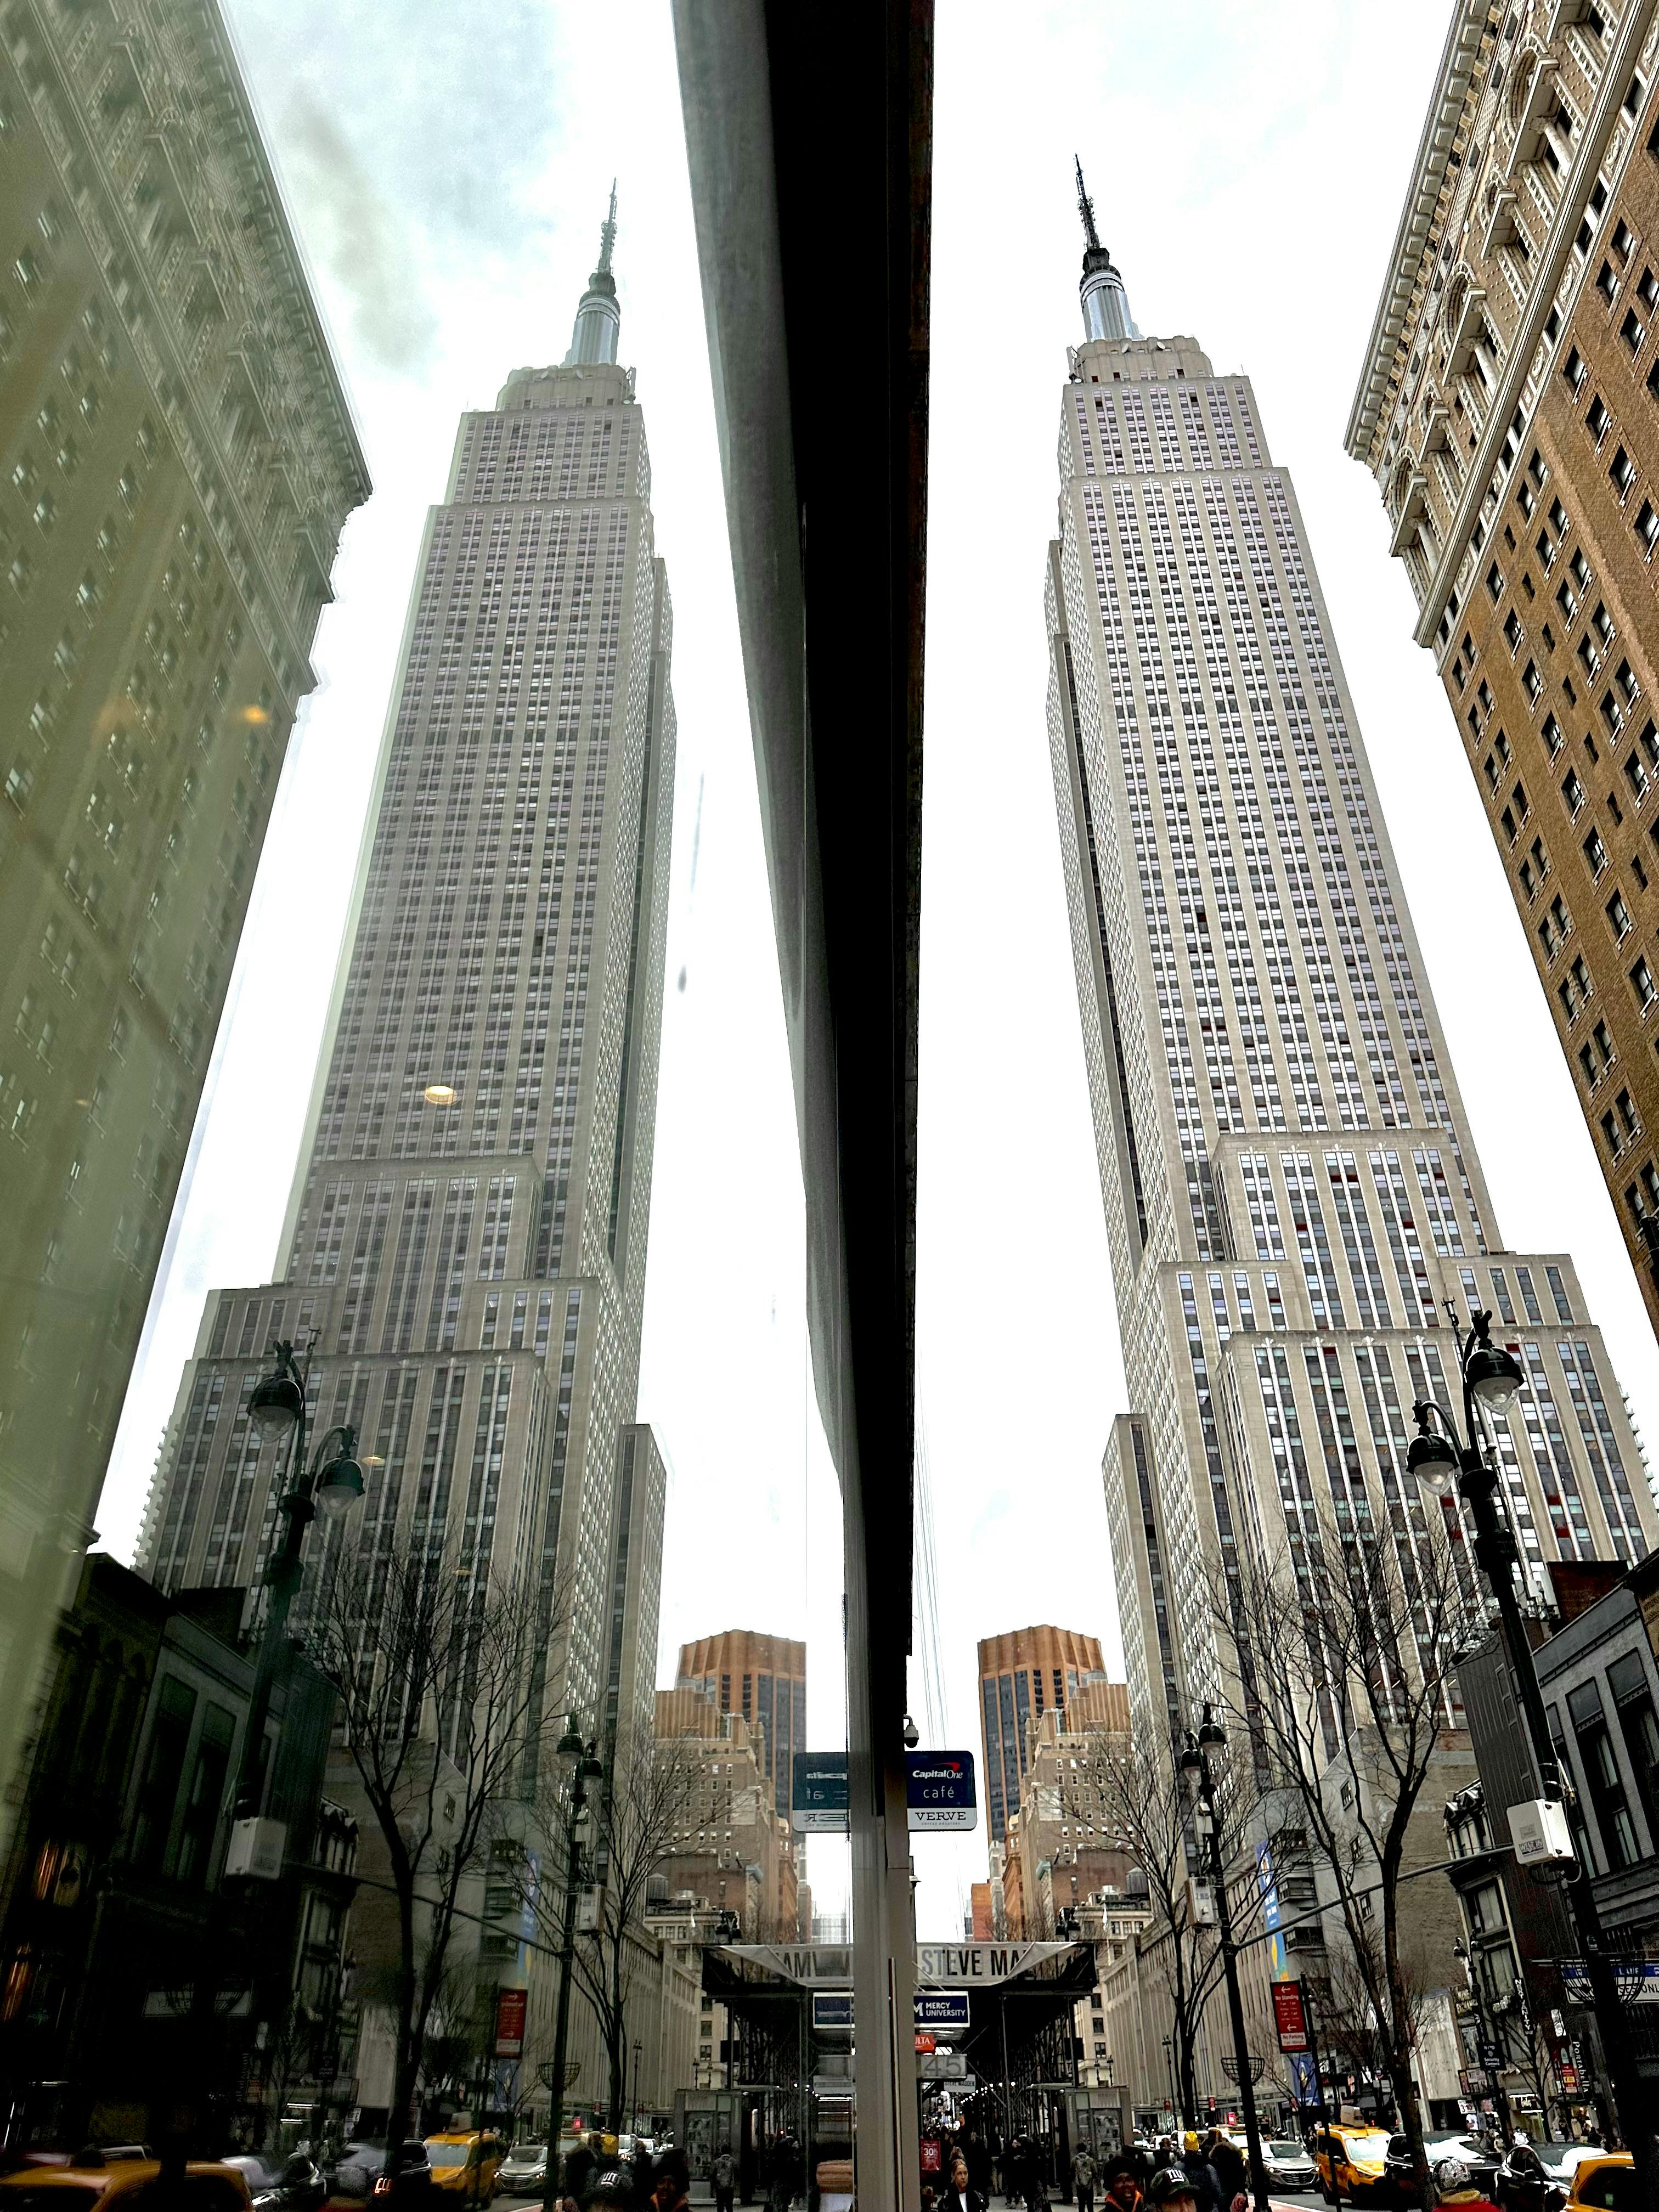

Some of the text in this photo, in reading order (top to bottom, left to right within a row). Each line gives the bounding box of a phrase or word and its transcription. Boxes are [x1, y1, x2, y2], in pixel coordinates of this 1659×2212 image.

[923, 1786, 955, 1798] café
[915, 1812, 966, 1820] VERVE
[921, 1949, 983, 1976] STEVE
[1641, 1984, 1659, 1994] ONL
[924, 2056, 962, 2077] 45
